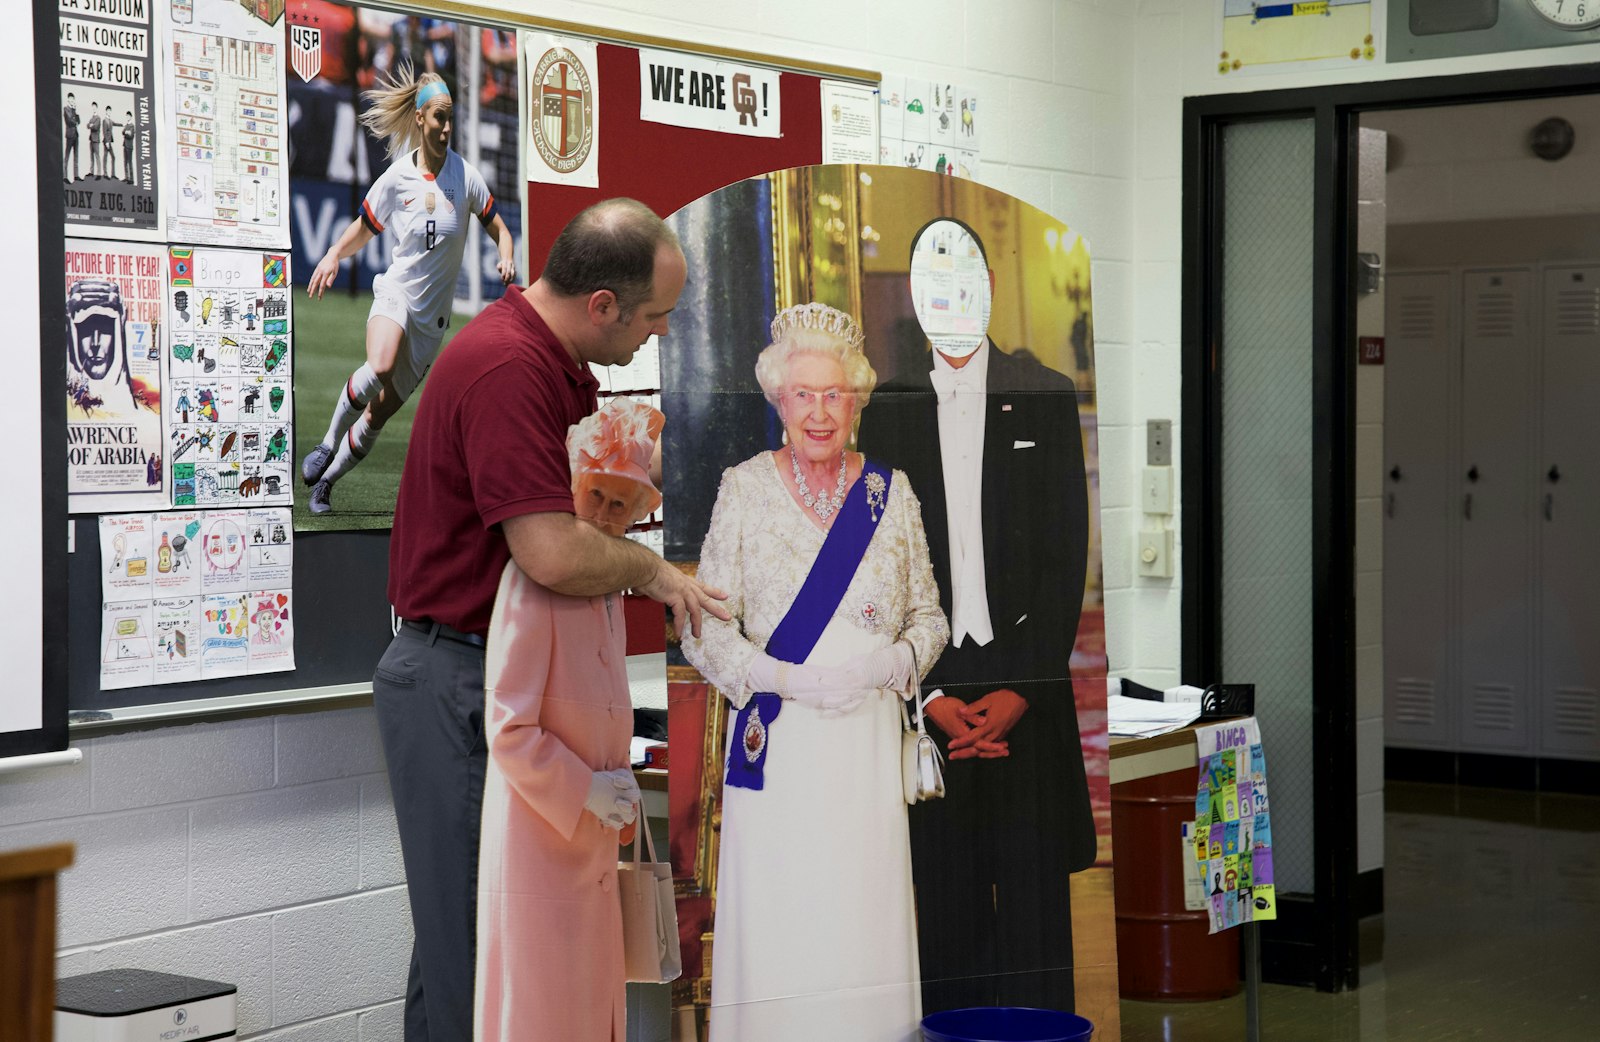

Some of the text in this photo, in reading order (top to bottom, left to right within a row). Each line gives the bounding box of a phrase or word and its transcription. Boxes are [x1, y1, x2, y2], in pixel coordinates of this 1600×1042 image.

[84, 0, 144, 18] STADIUM
[1577, 3, 1585, 17] 6
[77, 25, 89, 43] IN
[94, 28, 144, 51] CONCERT
[293, 28, 320, 50] USA
[82, 59, 103, 80] FAB
[108, 63, 140, 85] FOUR
[534, 50, 563, 86] GABRIE
[649, 64, 684, 103] WE
[689, 70, 726, 110] ARE
[100, 192, 126, 211] AUG.
[131, 195, 154, 214] 15th
[426, 220, 435, 250] 8
[65, 251, 161, 278] PICTURE OF THE YEAR!
[201, 257, 240, 284] Bingo
[136, 280, 161, 300] YEAR!
[135, 331, 145, 343] 7
[70, 448, 147, 465] OF ARABIA
[205, 609, 227, 622] TOYS
[218, 622, 232, 635] US
[1216, 727, 1246, 752] BINGO
